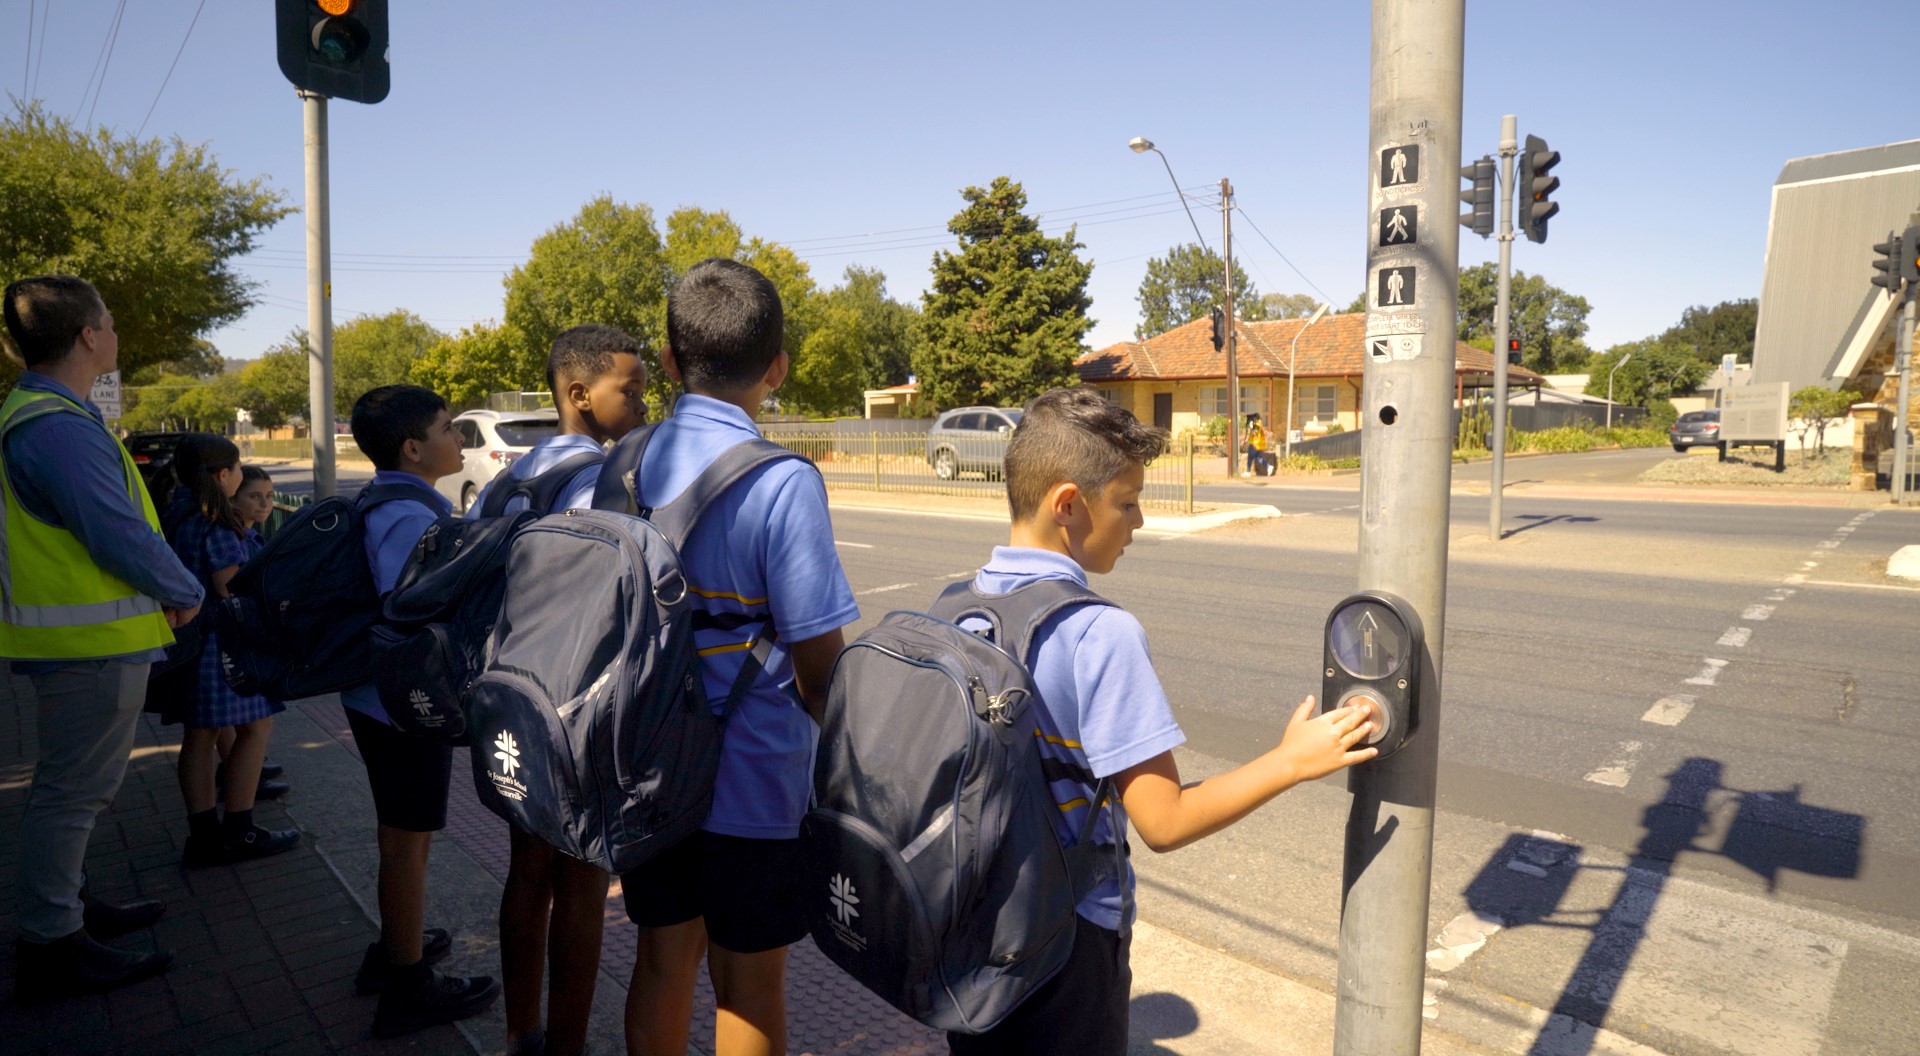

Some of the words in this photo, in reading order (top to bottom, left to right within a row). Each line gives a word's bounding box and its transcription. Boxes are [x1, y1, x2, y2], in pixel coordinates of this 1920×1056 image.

[1384, 187, 1398, 196] NOT
[1399, 184, 1425, 193] CROSS
[1380, 322, 1400, 330] START
[1402, 321, 1412, 329] TO
[94, 391, 115, 399] LANE
[492, 771, 514, 785] Joseph's
[513, 778, 528, 793] School
